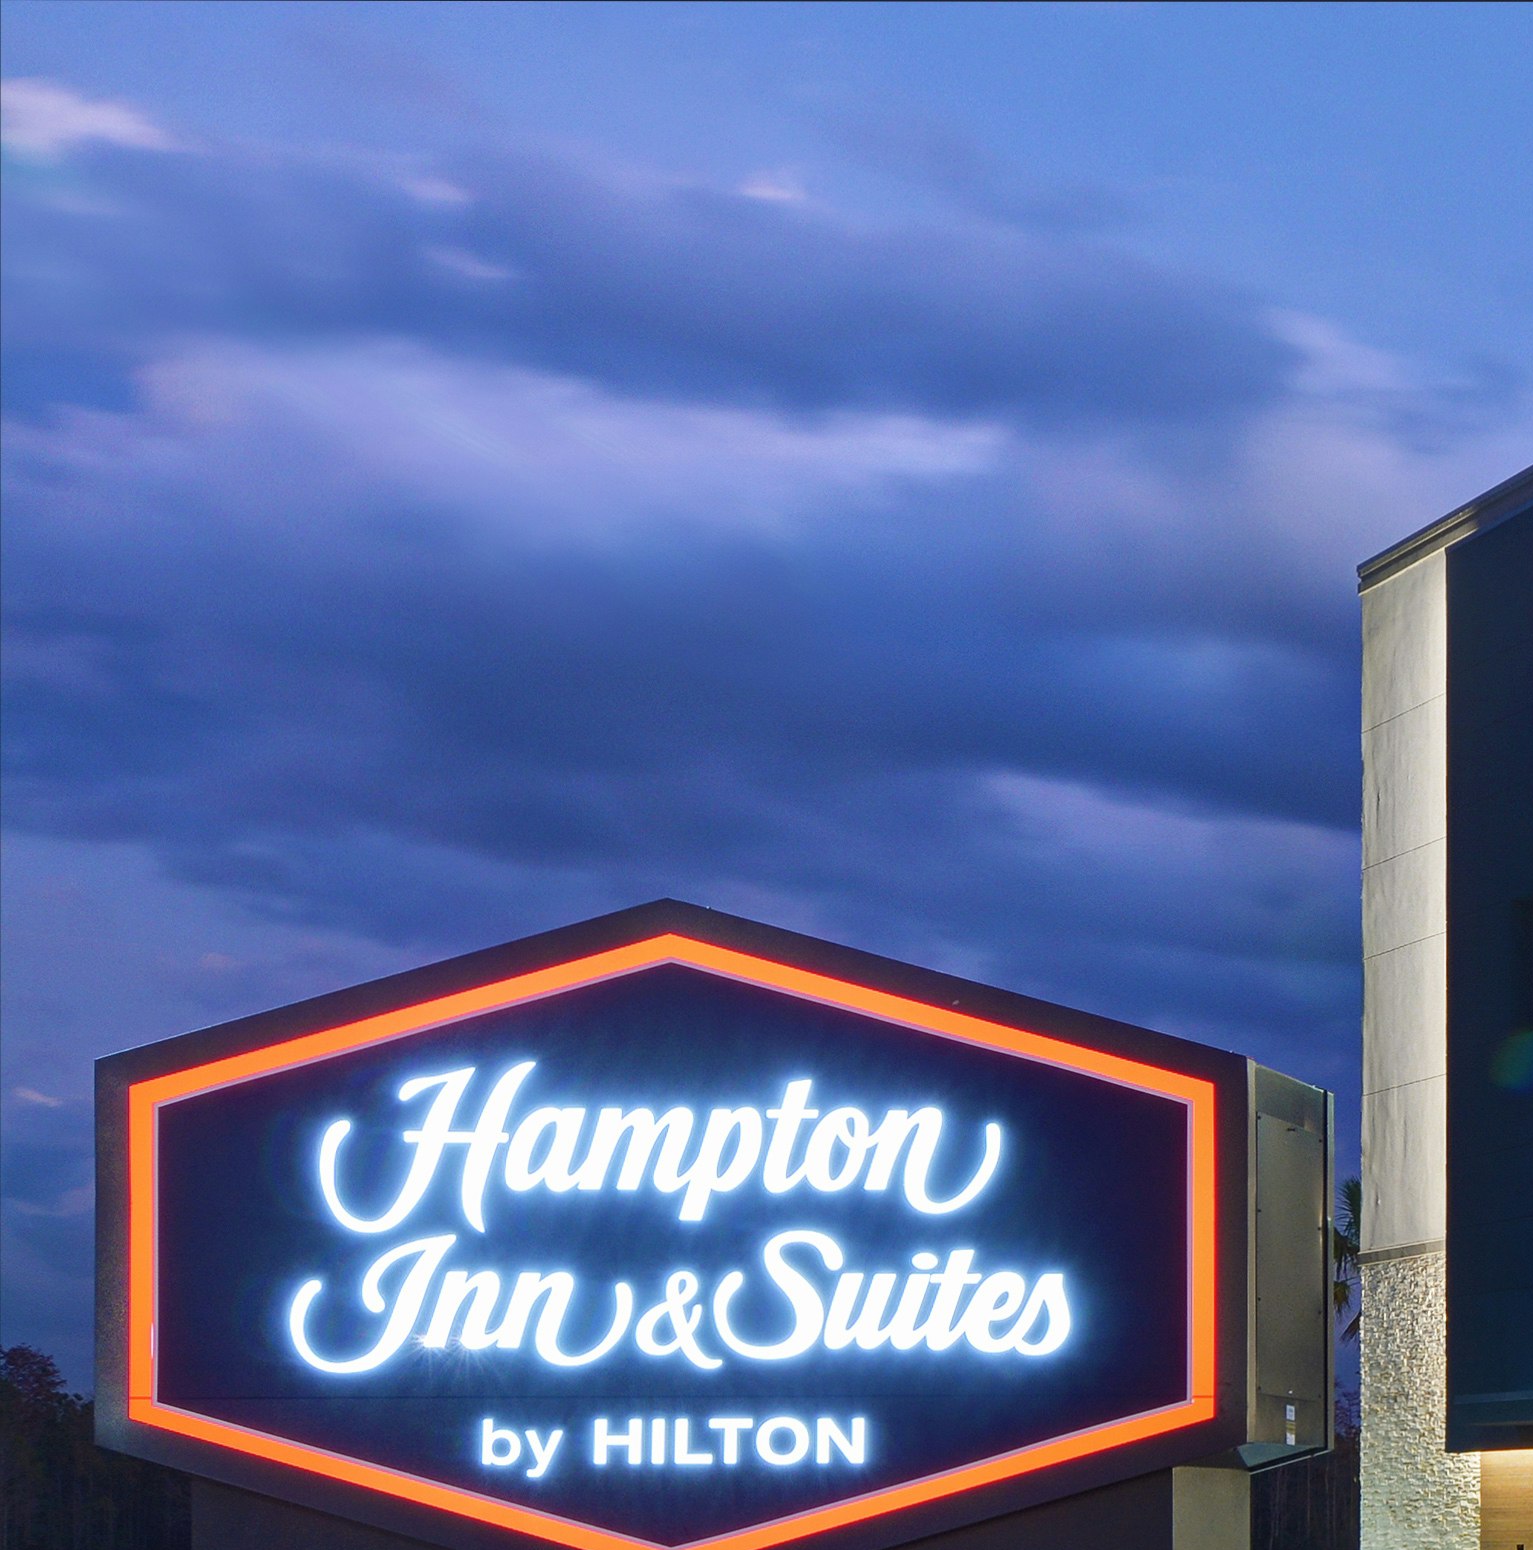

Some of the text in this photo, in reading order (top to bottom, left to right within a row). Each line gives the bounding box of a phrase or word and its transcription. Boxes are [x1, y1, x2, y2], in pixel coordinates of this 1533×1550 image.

[317, 1060, 1002, 1234] Hampton
[288, 1229, 1072, 1375] Inn & Suites
[481, 1416, 867, 1478] by HILTON
